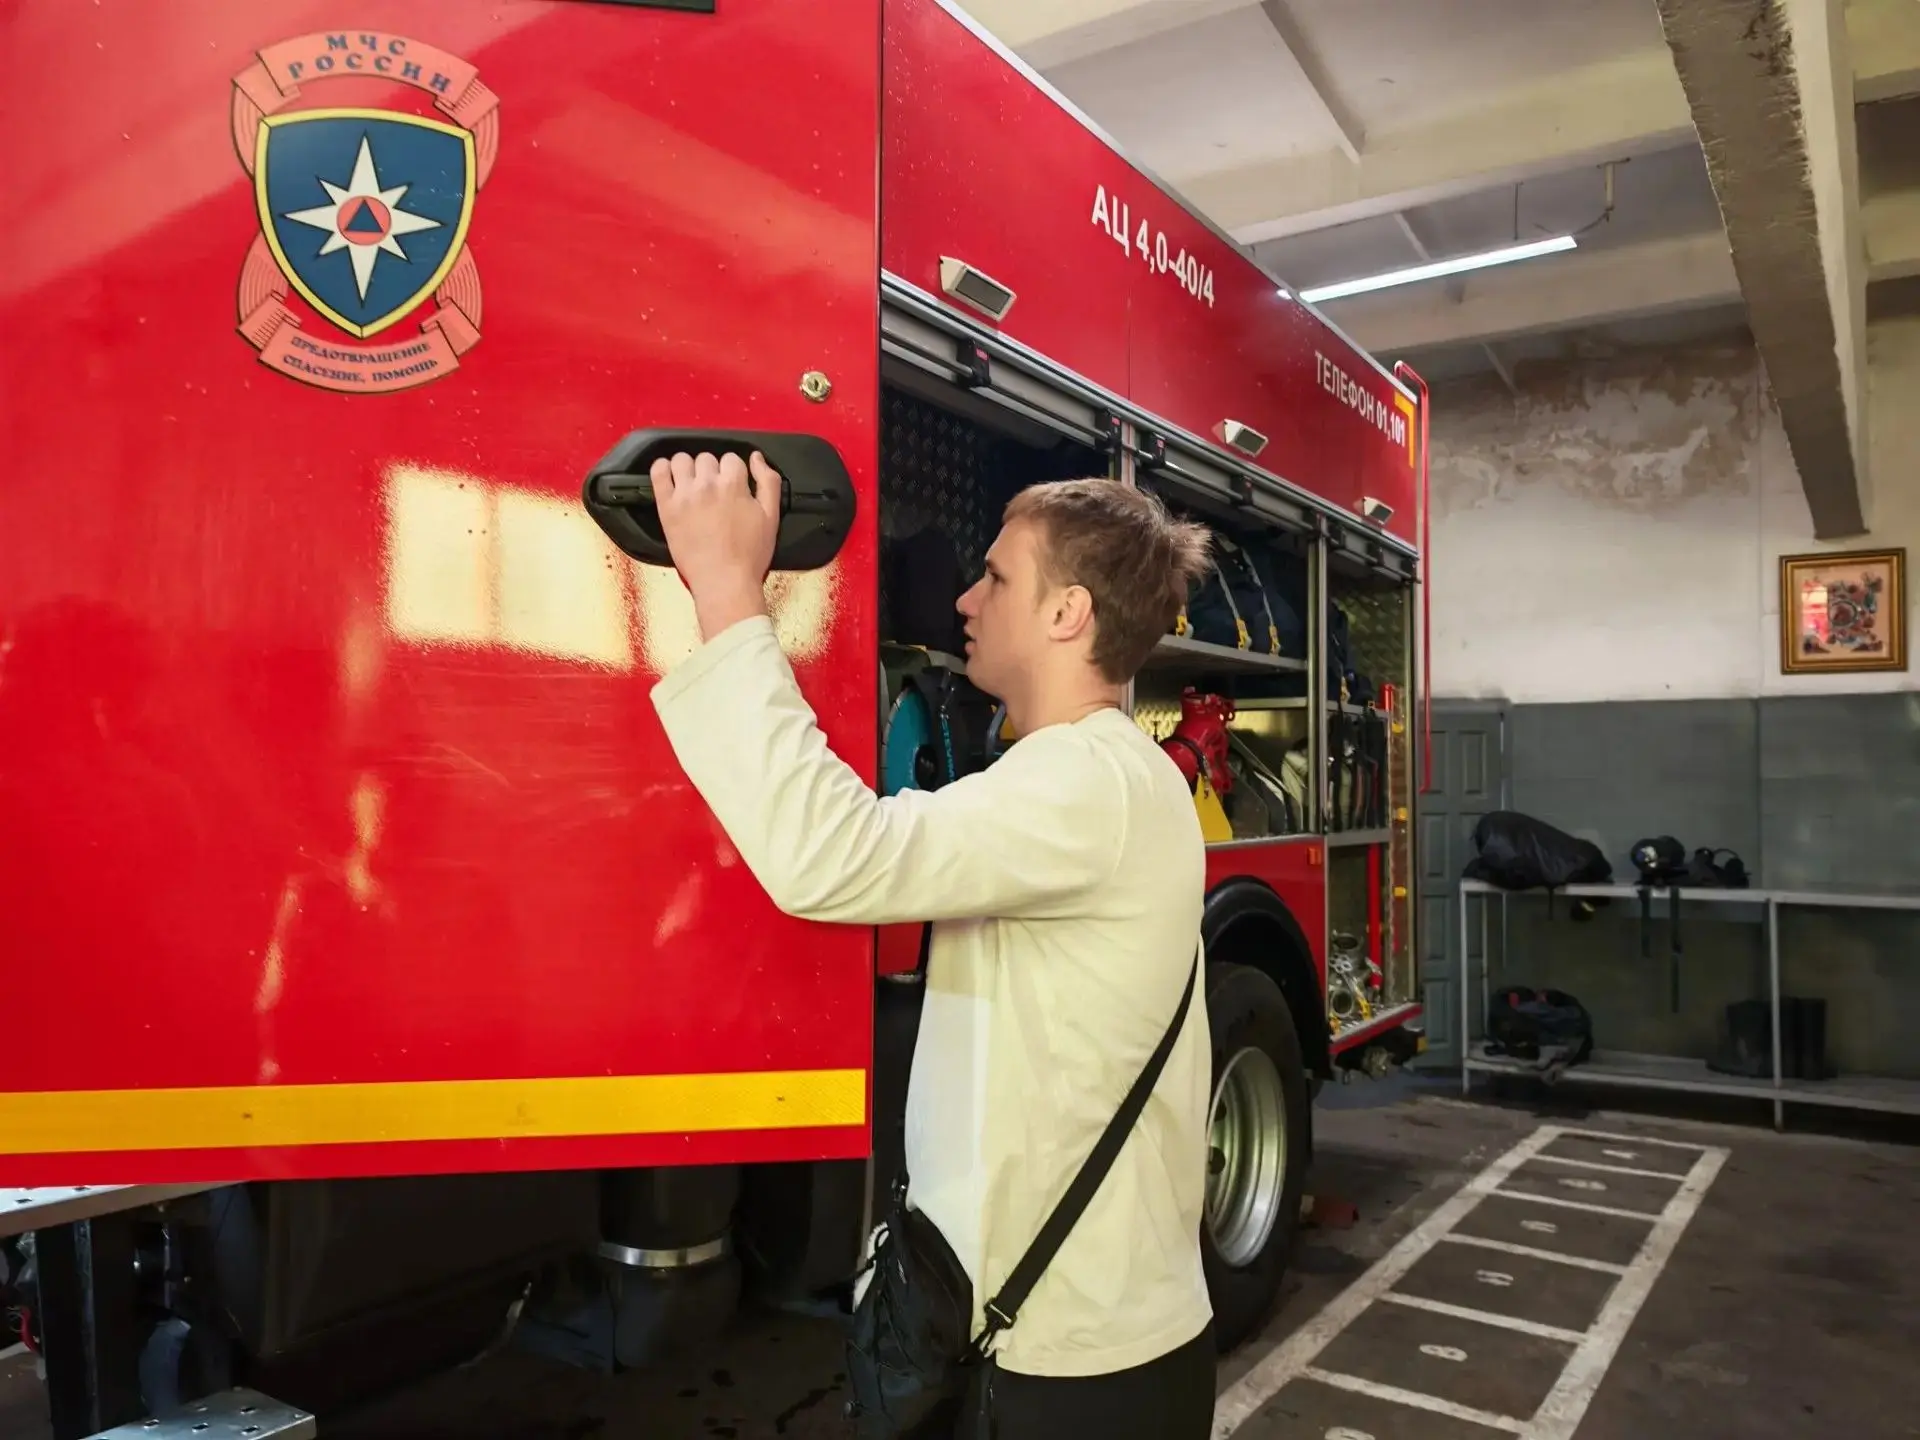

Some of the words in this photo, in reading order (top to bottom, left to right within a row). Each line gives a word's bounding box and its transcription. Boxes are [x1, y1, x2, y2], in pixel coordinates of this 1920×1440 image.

[326, 34, 406, 56] МЧС
[288, 53, 450, 92] РОССИИ
[1091, 184, 1130, 258] АЦ
[1136, 218, 1215, 309] 4,0-40/4
[372, 359, 438, 383] ПОМОЩЬ
[1315, 350, 1375, 424] ТЕЛЕФОН
